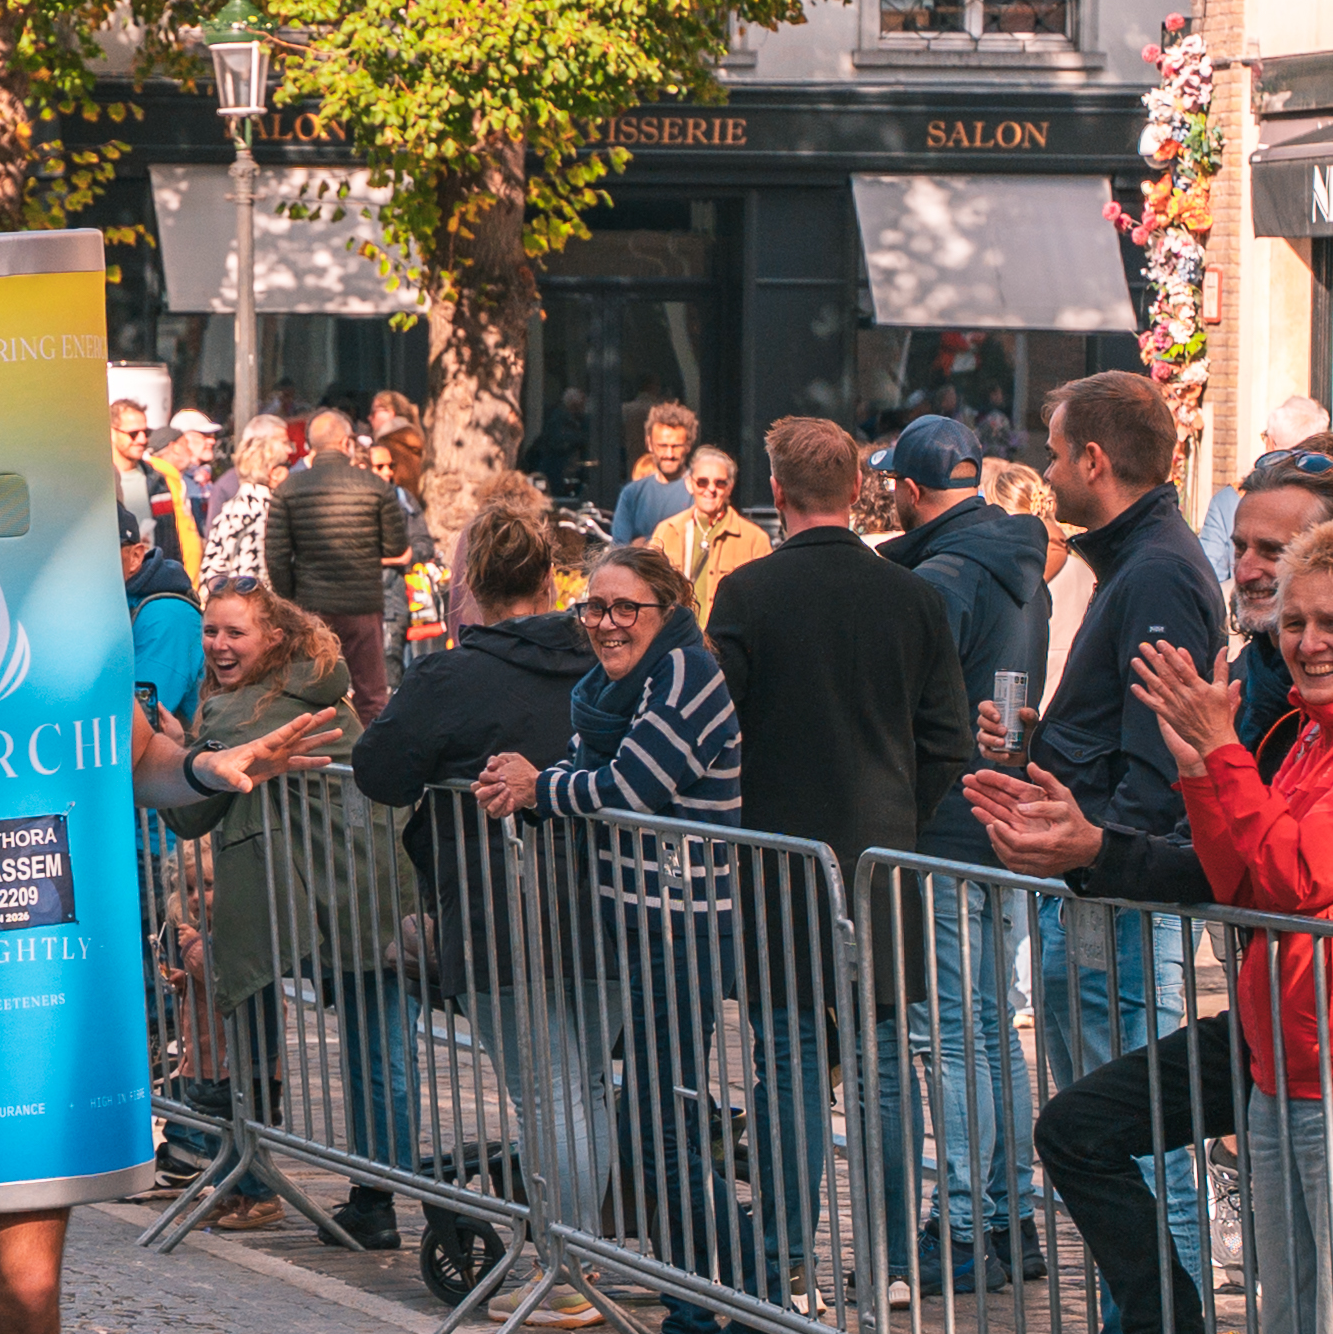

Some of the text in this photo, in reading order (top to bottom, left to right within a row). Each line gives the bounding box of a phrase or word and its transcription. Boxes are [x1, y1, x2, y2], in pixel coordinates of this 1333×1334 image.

[577, 116, 748, 146] TISSERIE
[927, 120, 1051, 148] SALON
[5, 911, 30, 923] 2026
[90, 1095, 113, 1108] HIGH
